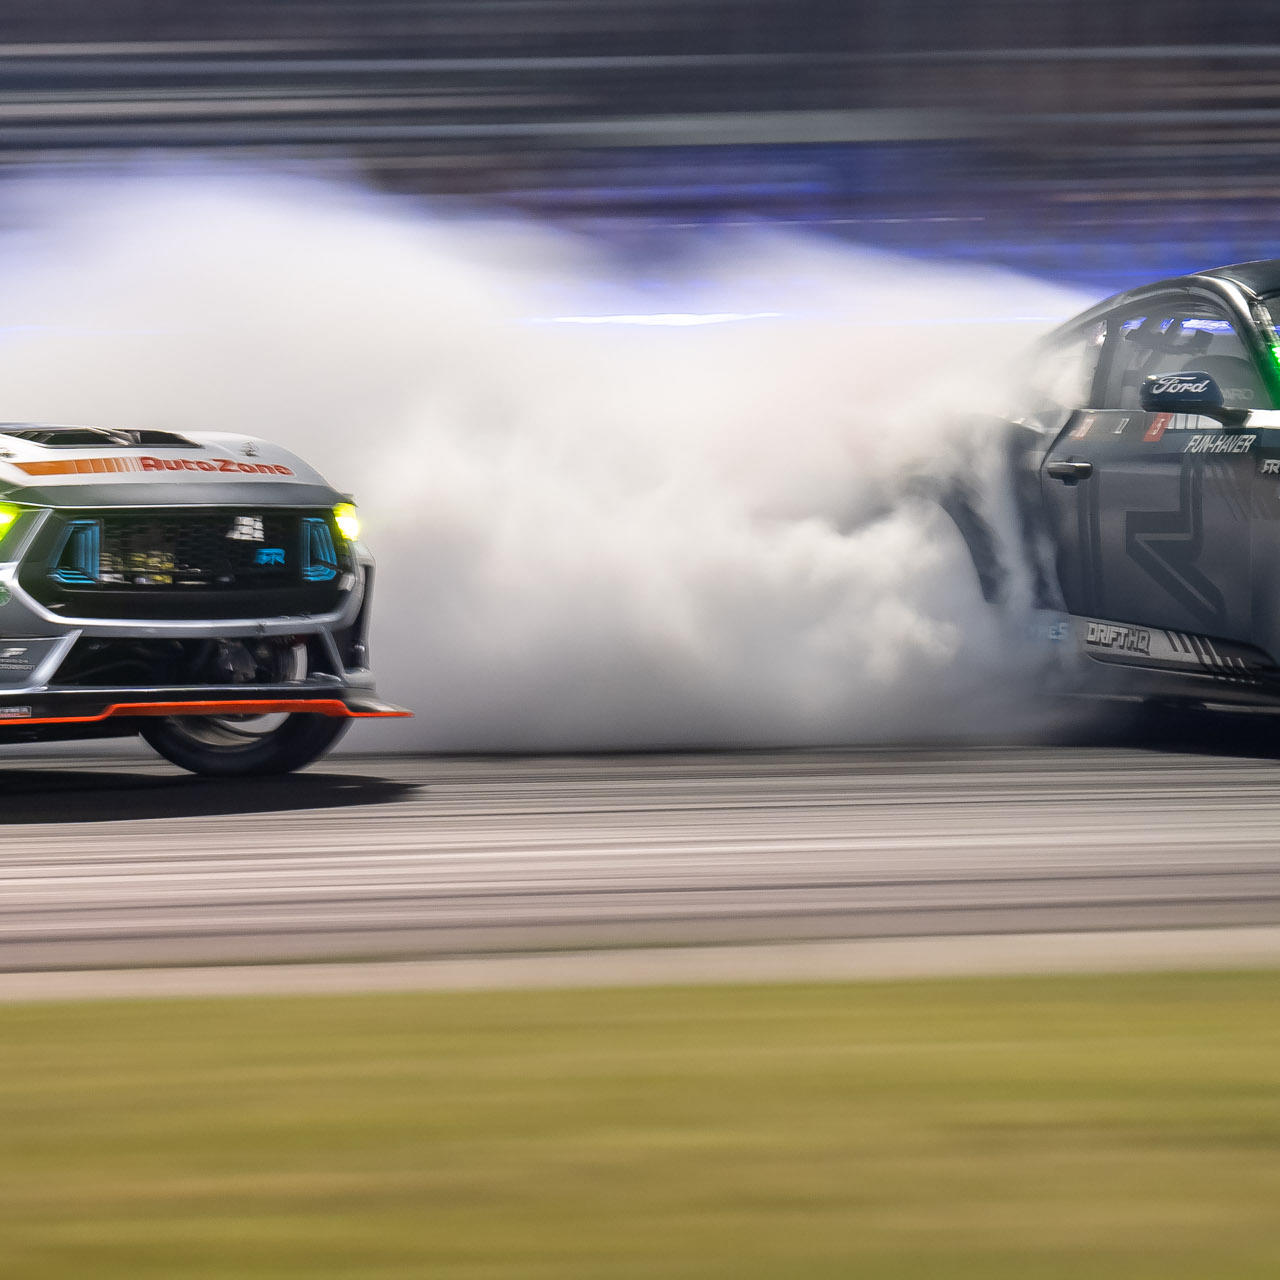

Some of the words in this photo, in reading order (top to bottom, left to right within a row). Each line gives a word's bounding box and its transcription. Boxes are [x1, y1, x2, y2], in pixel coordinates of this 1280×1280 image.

[1152, 376, 1210, 394] Ford
[1184, 434, 1257, 454] FUN-HAVER
[138, 456, 295, 476] AutoZone
